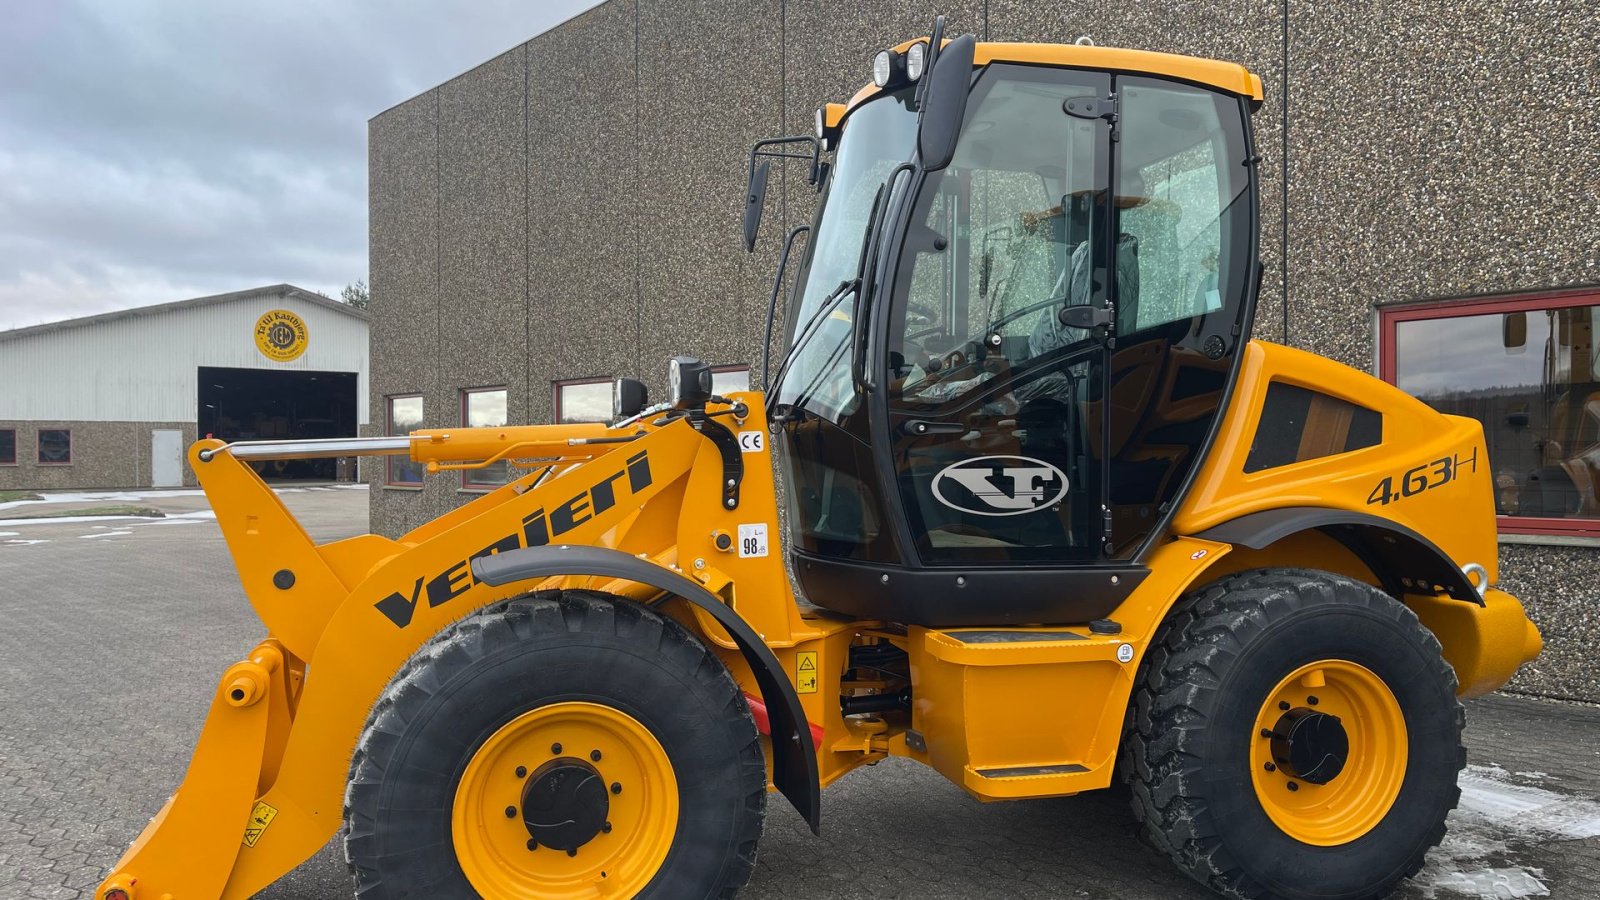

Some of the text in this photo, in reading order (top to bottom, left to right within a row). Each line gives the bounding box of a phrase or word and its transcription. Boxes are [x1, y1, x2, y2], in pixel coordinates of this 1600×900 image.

[273, 312, 305, 341] Kastbjerg
[742, 435, 761, 449] CE
[1366, 446, 1477, 505] 4.63H
[743, 537, 758, 555] 98
